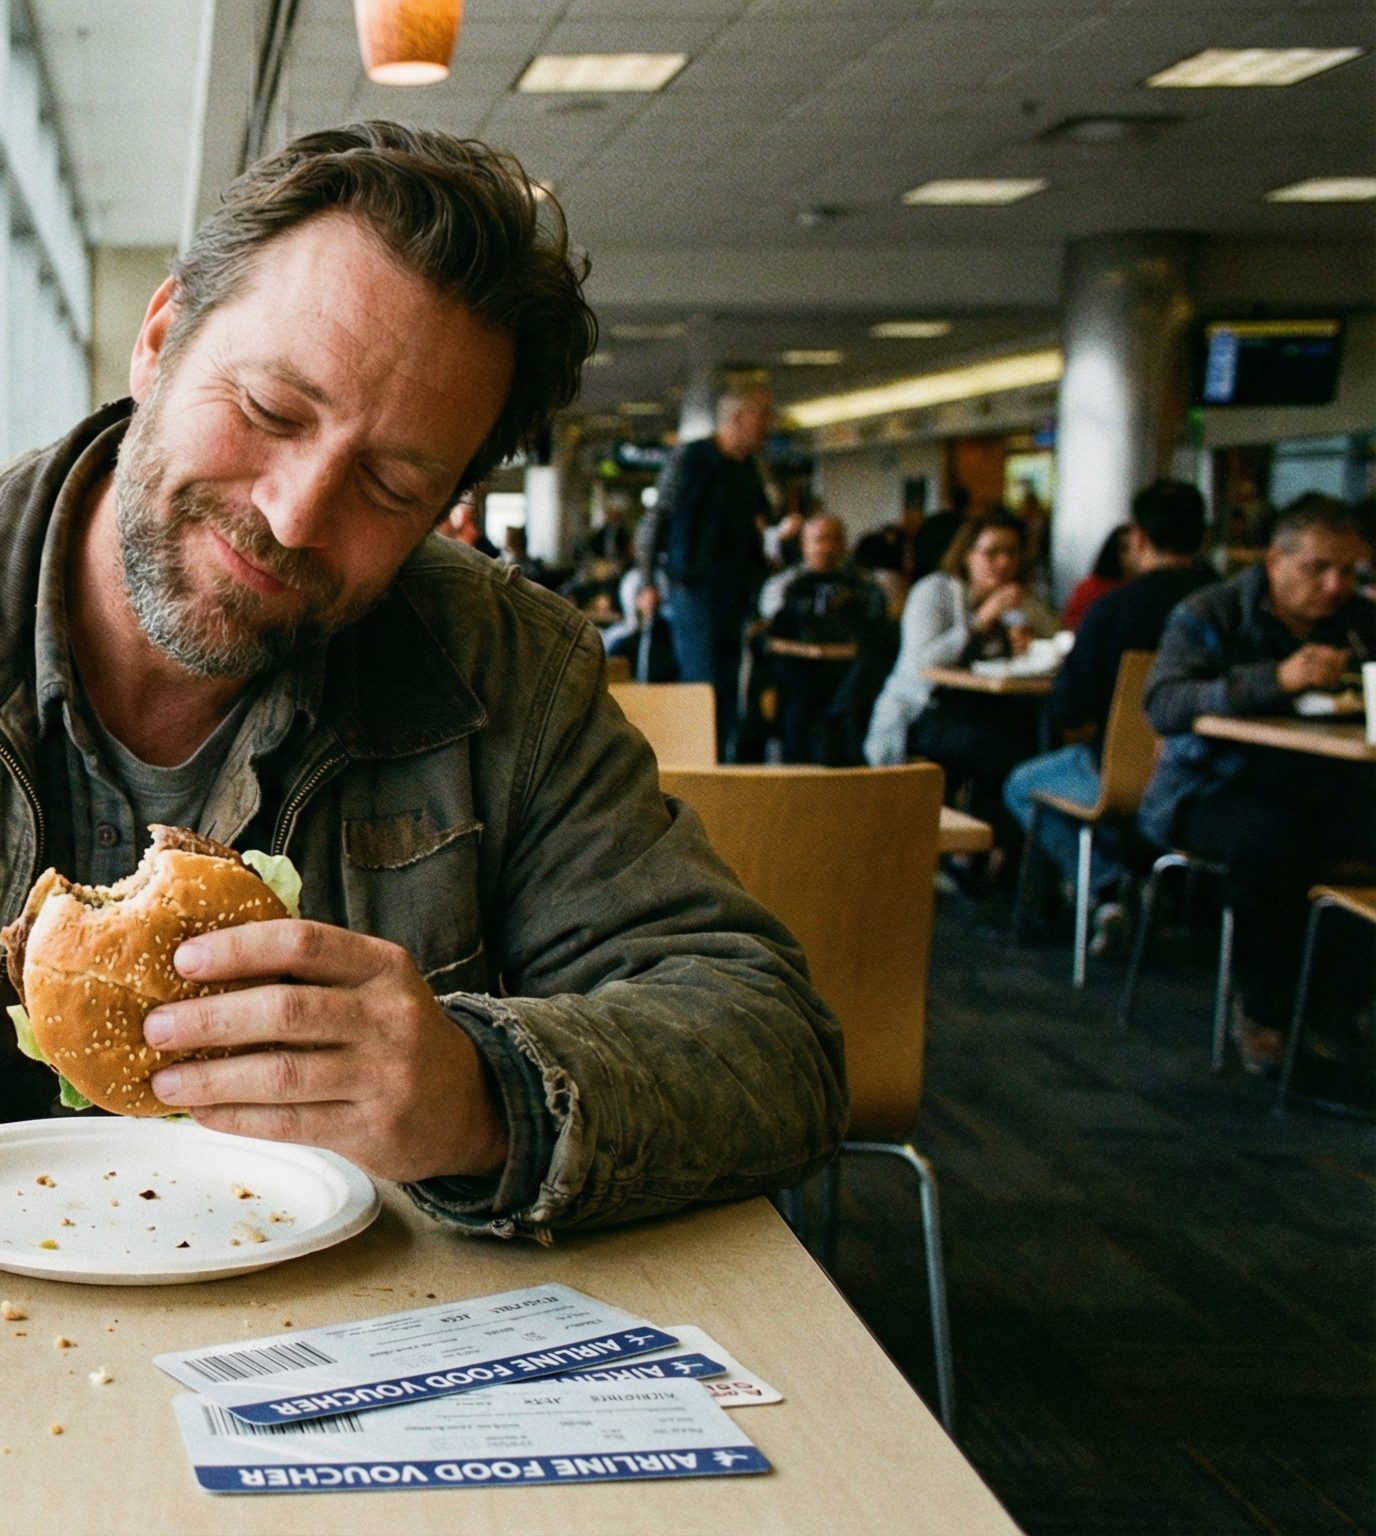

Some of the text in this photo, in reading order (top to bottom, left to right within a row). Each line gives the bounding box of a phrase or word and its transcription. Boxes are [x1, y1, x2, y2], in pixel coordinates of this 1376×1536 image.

[269, 1337, 623, 1416] AIRLINE FOOD VOUCHER
[238, 1452, 698, 1487] AIRLINE FOOD VOUCHER
